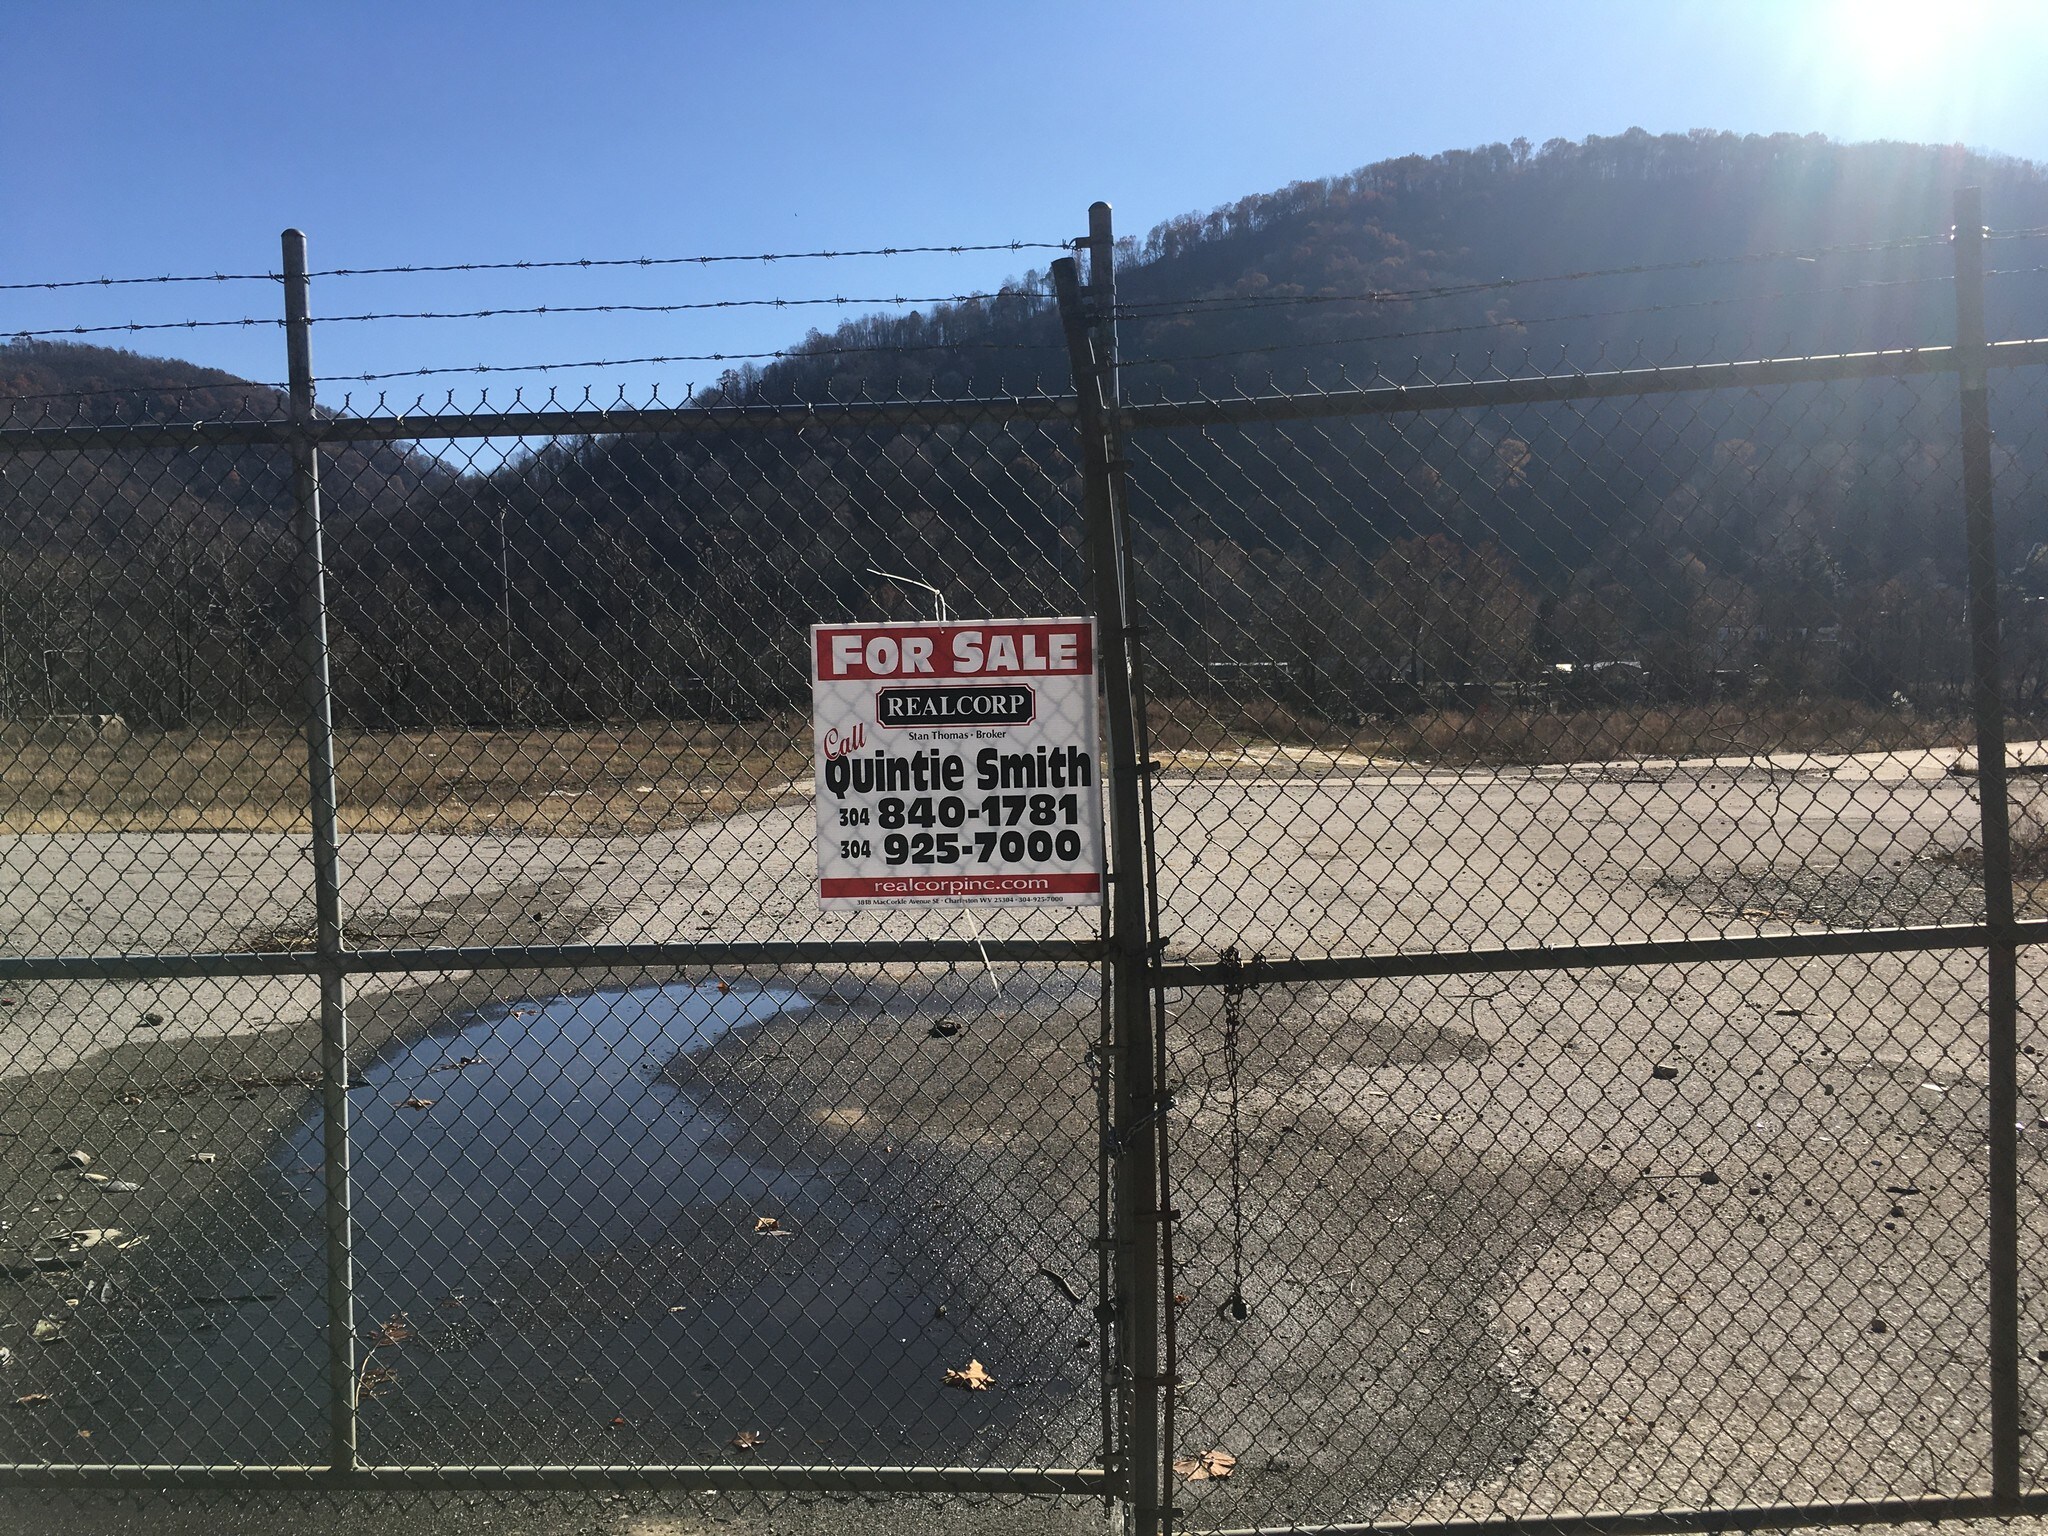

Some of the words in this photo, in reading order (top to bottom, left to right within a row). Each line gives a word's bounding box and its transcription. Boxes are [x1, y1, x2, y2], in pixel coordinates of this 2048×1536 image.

[832, 635, 934, 675] FOR
[952, 631, 1078, 672] SALE
[888, 695, 1024, 717] REALCORP
[824, 722, 866, 760] Call
[908, 732, 930, 740] Stan
[932, 730, 968, 740] Thomas
[976, 730, 1006, 739] Broker
[826, 749, 964, 799] Quintie
[977, 746, 1091, 790] Smith
[840, 808, 870, 826] 304
[878, 794, 1078, 829] 840-1781
[841, 840, 871, 858] 304
[884, 830, 1080, 864] 925-7000
[875, 878, 1048, 894] realcorpinc.com
